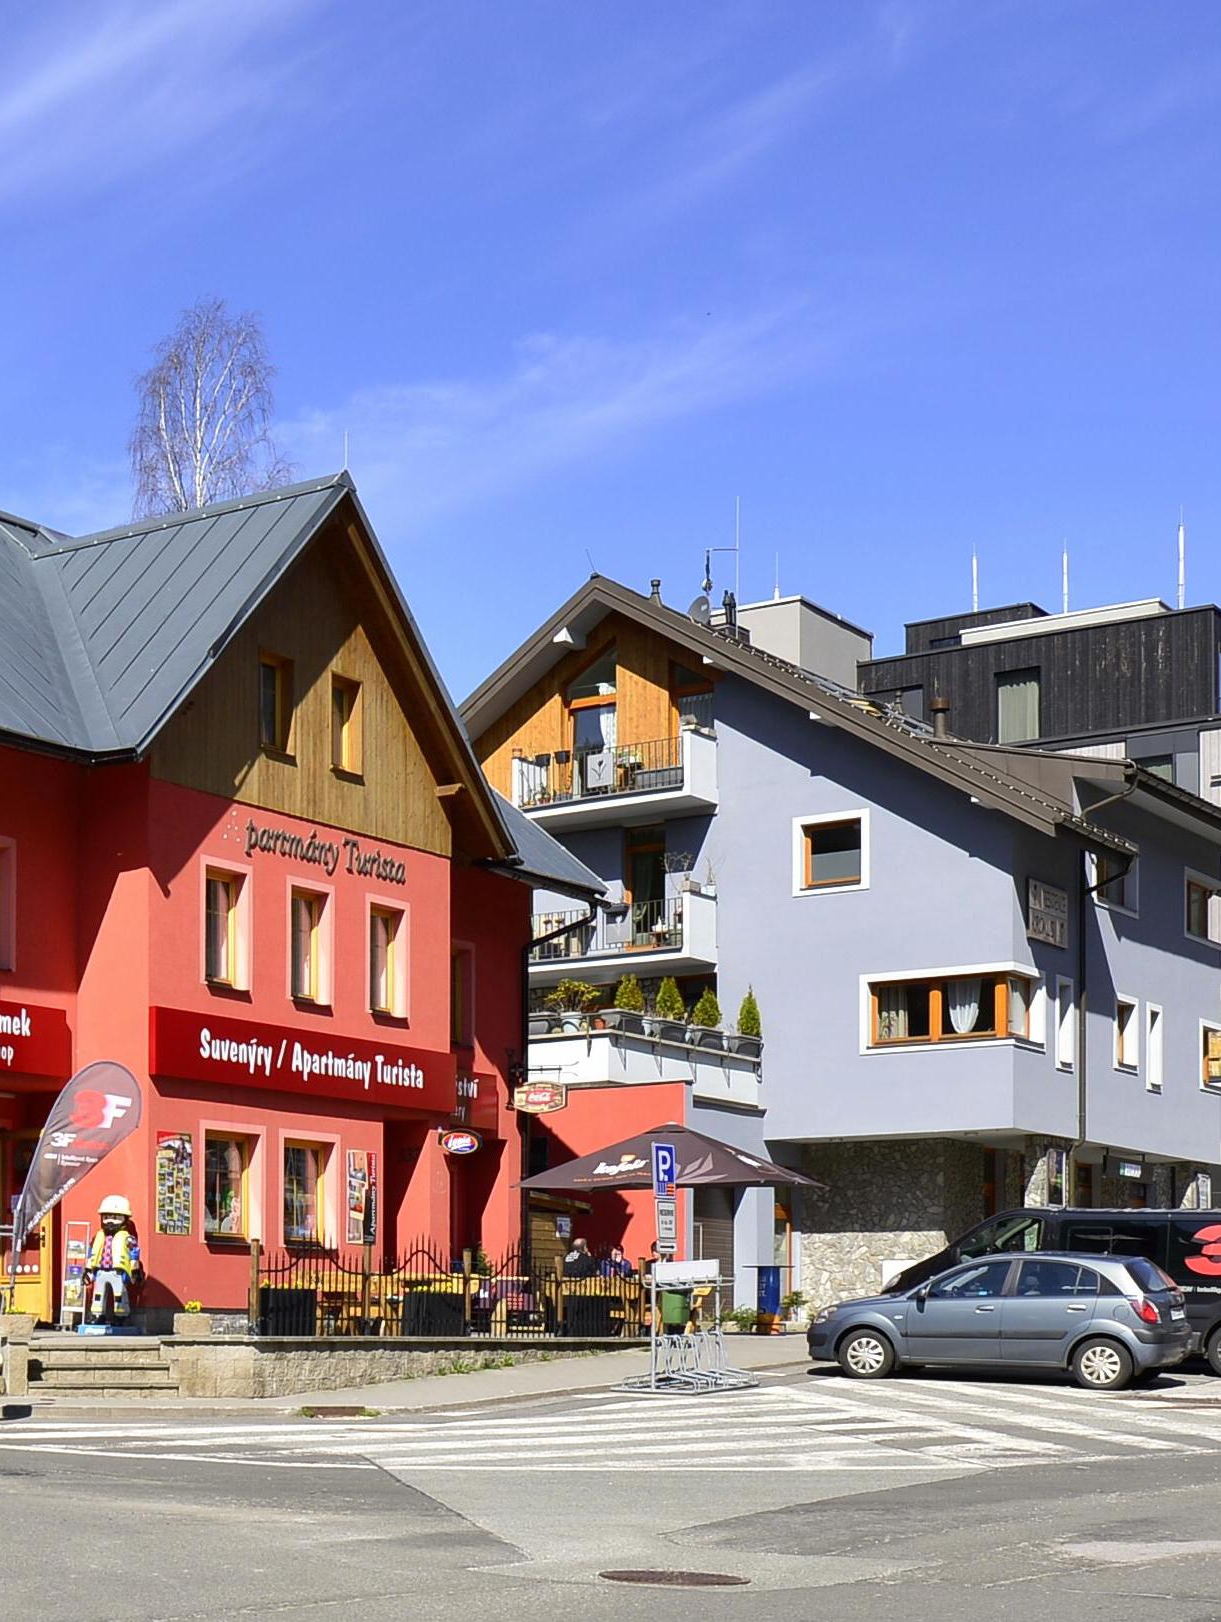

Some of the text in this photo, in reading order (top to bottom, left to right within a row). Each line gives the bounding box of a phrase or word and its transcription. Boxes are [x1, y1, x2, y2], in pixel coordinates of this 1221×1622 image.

[343, 837, 407, 885] Turista
[200, 1028, 424, 1089] Suvenýry / Apartmány Turista
[456, 1075, 479, 1099] ství
[50, 1132, 77, 1148] 3F
[658, 1150, 671, 1181] P
